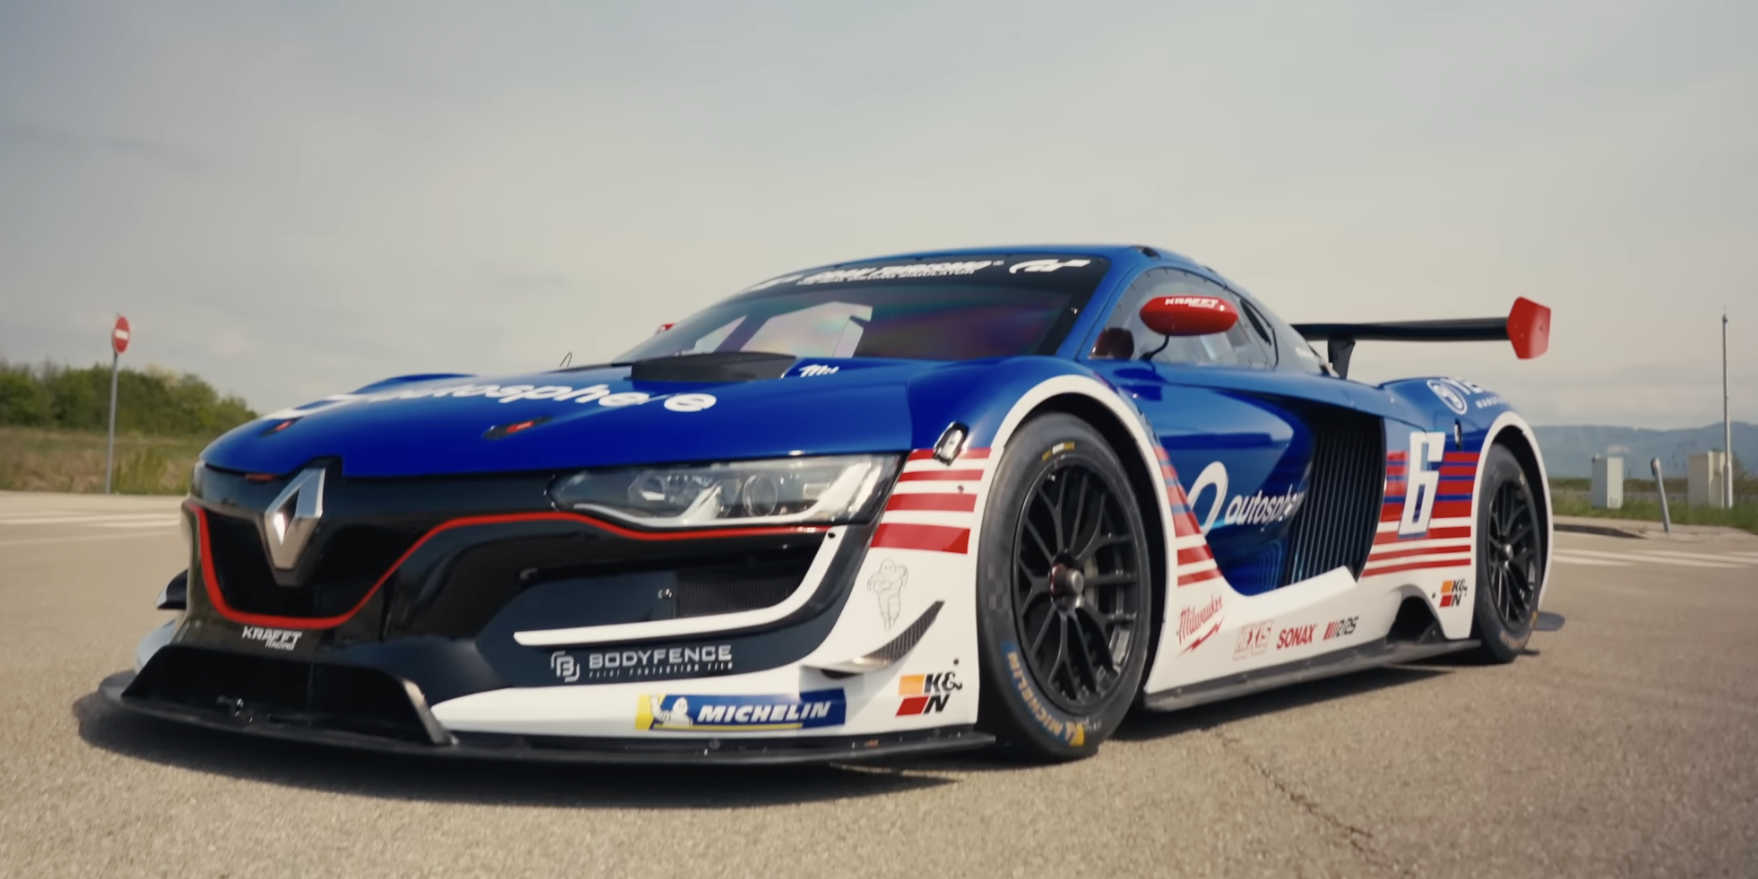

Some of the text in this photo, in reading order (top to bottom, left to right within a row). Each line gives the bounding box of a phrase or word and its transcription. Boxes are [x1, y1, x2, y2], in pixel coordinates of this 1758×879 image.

[1398, 431, 1446, 539] 6
[1177, 593, 1223, 645] Milwaukee
[241, 625, 303, 645] KRAFFT
[1276, 623, 1316, 650] SONAX
[588, 644, 733, 670] BODYFENCE
[923, 671, 963, 694] K&
[697, 700, 832, 724] MICHELIN
[923, 693, 952, 715] N
